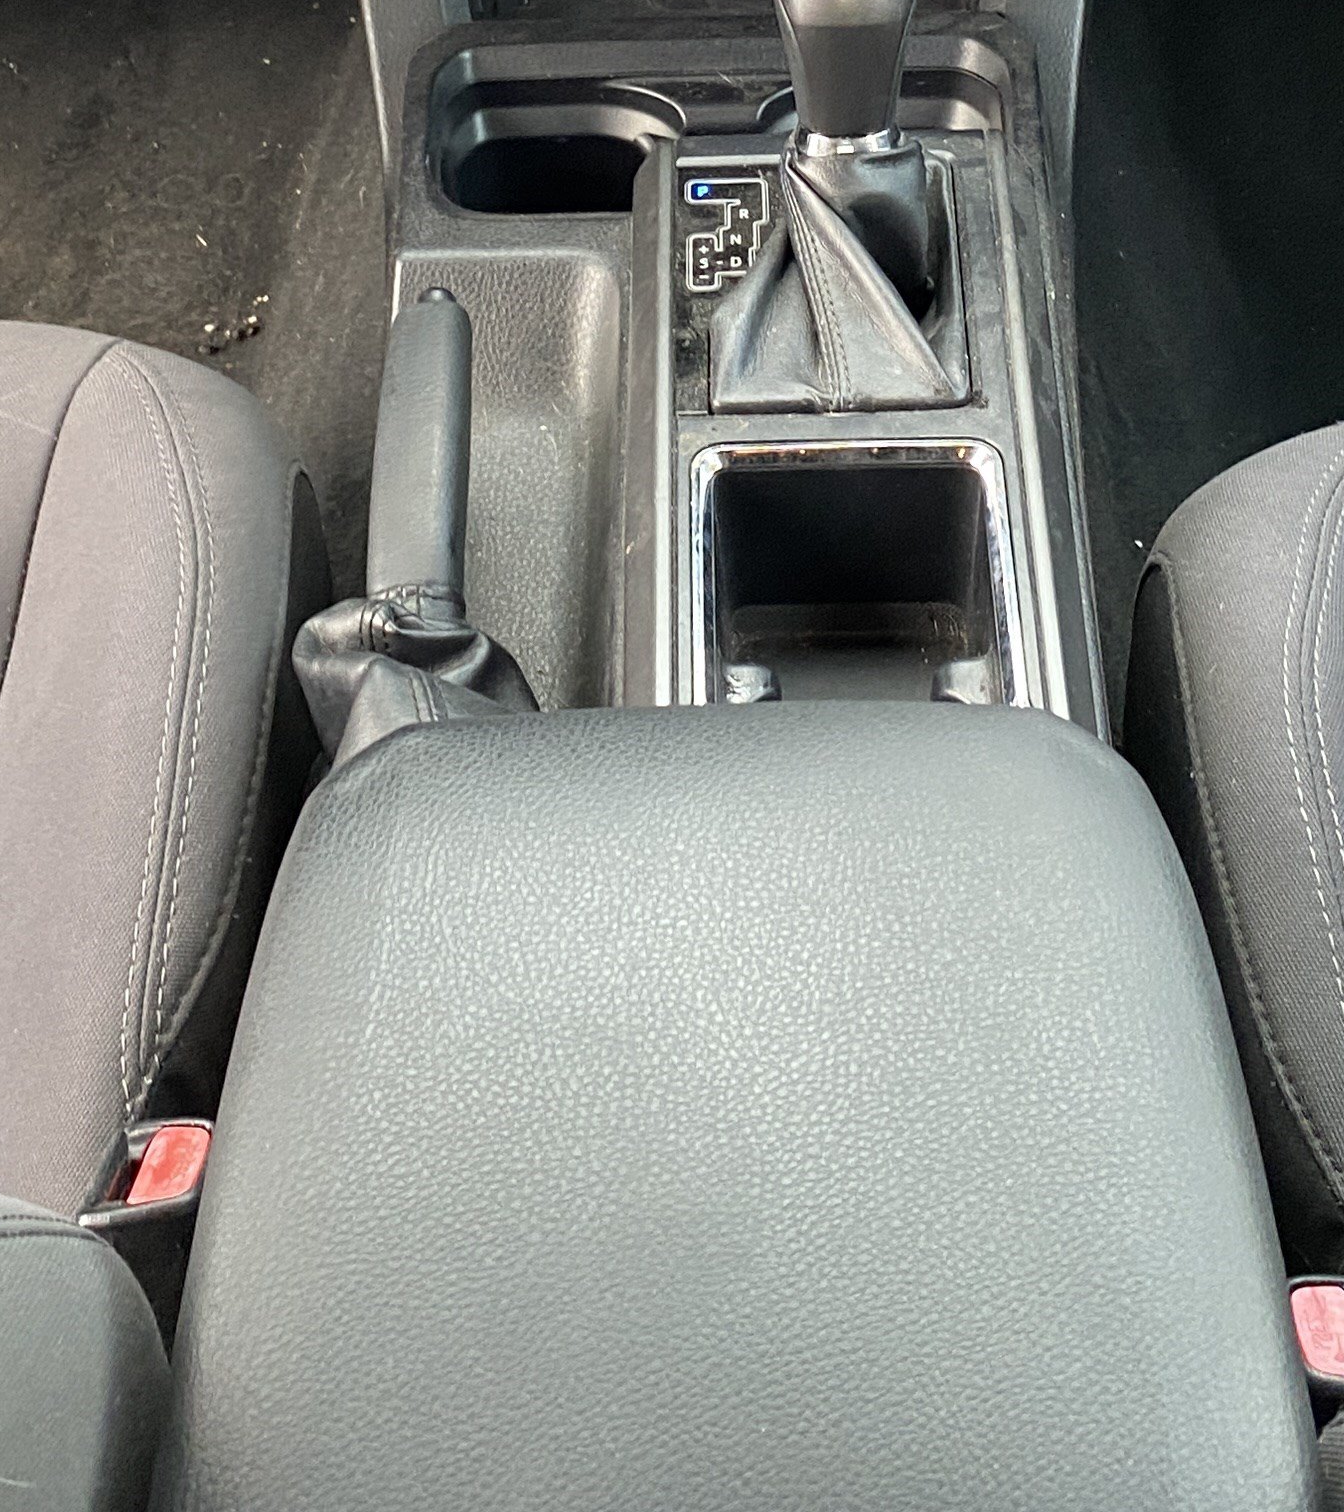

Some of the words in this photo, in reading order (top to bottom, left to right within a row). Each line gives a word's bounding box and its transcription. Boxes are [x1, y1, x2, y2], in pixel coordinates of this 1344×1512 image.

[696, 184, 709, 198] P
[738, 208, 750, 220] R
[729, 233, 742, 245] N
[699, 257, 709, 270] S
[729, 256, 743, 268] D
